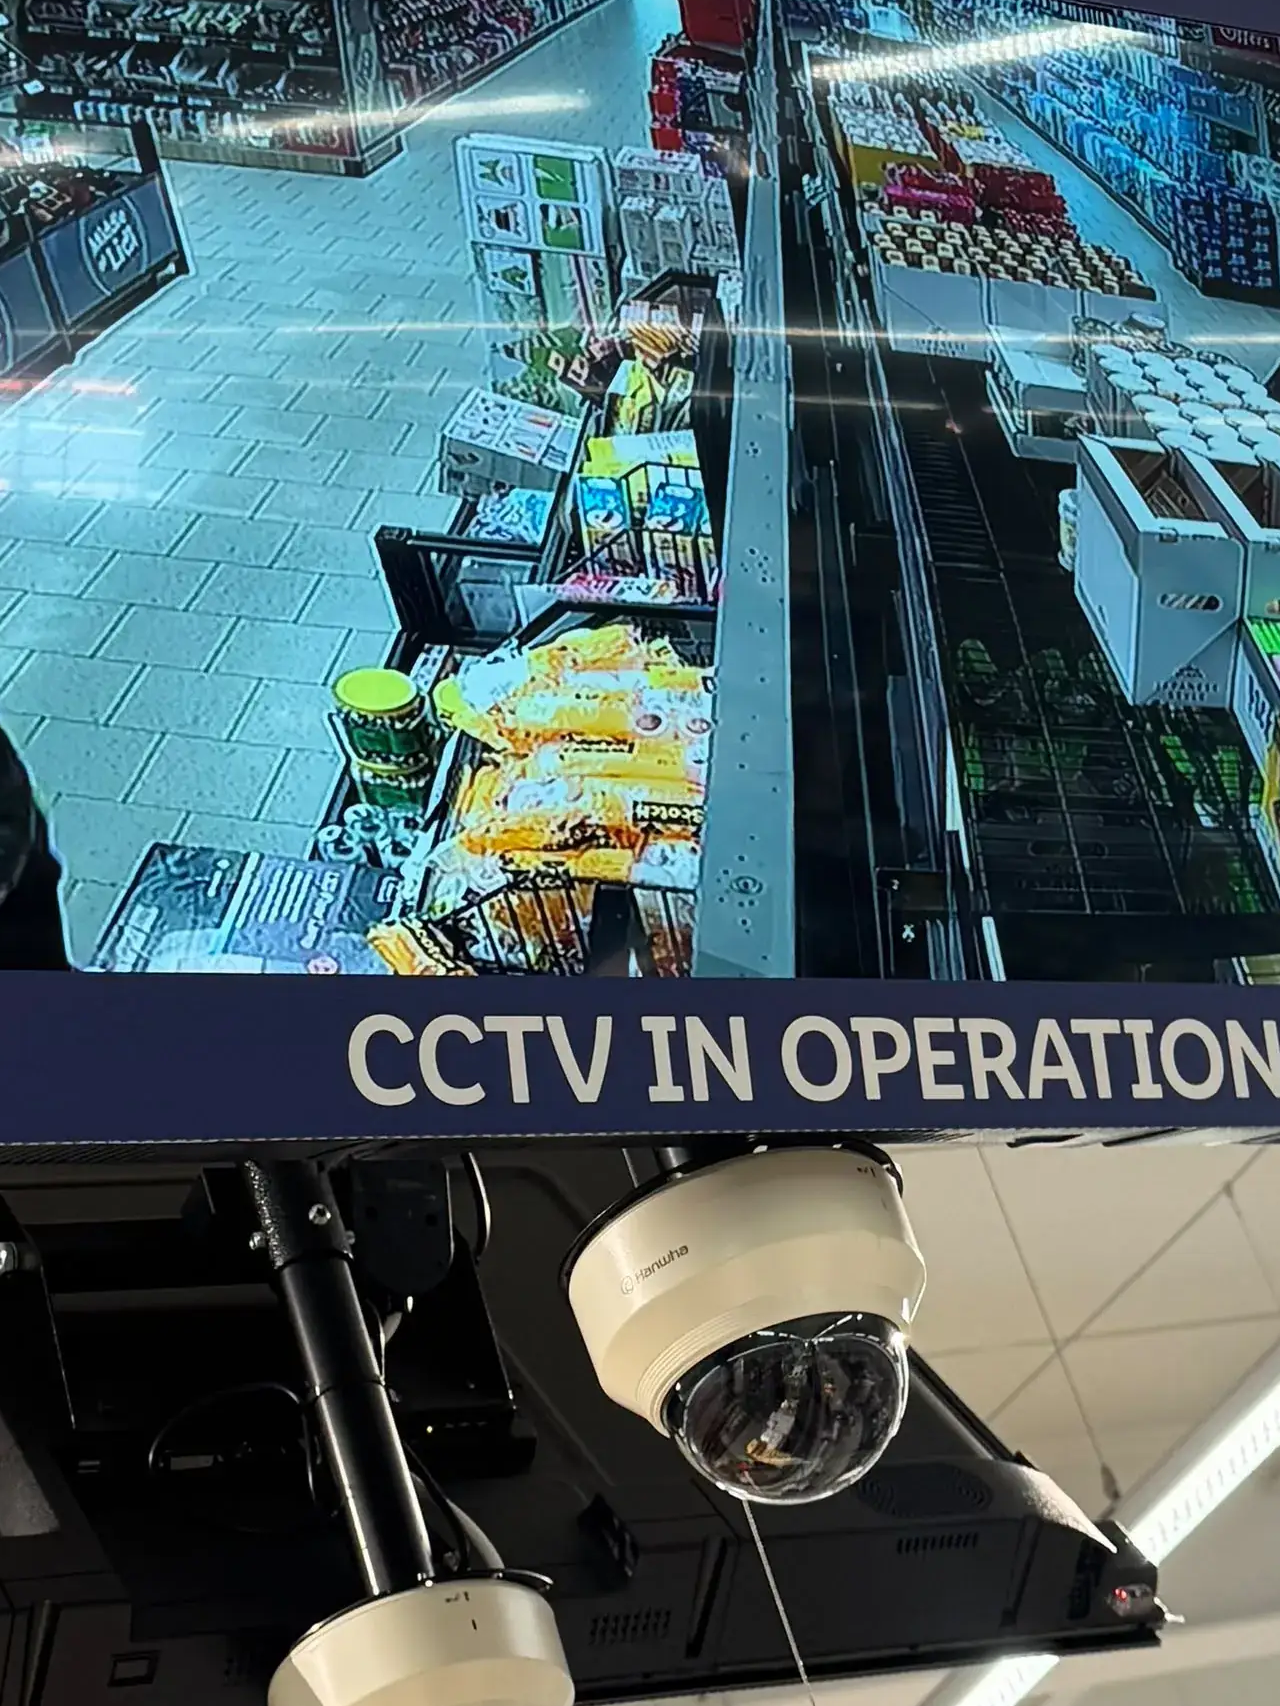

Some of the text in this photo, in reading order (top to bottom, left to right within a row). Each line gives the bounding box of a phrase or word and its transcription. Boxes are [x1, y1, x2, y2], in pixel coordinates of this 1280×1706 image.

[347, 1013, 614, 1107] CCTV
[640, 1015, 755, 1102] IN
[634, 1244, 690, 1285] Hanwha
